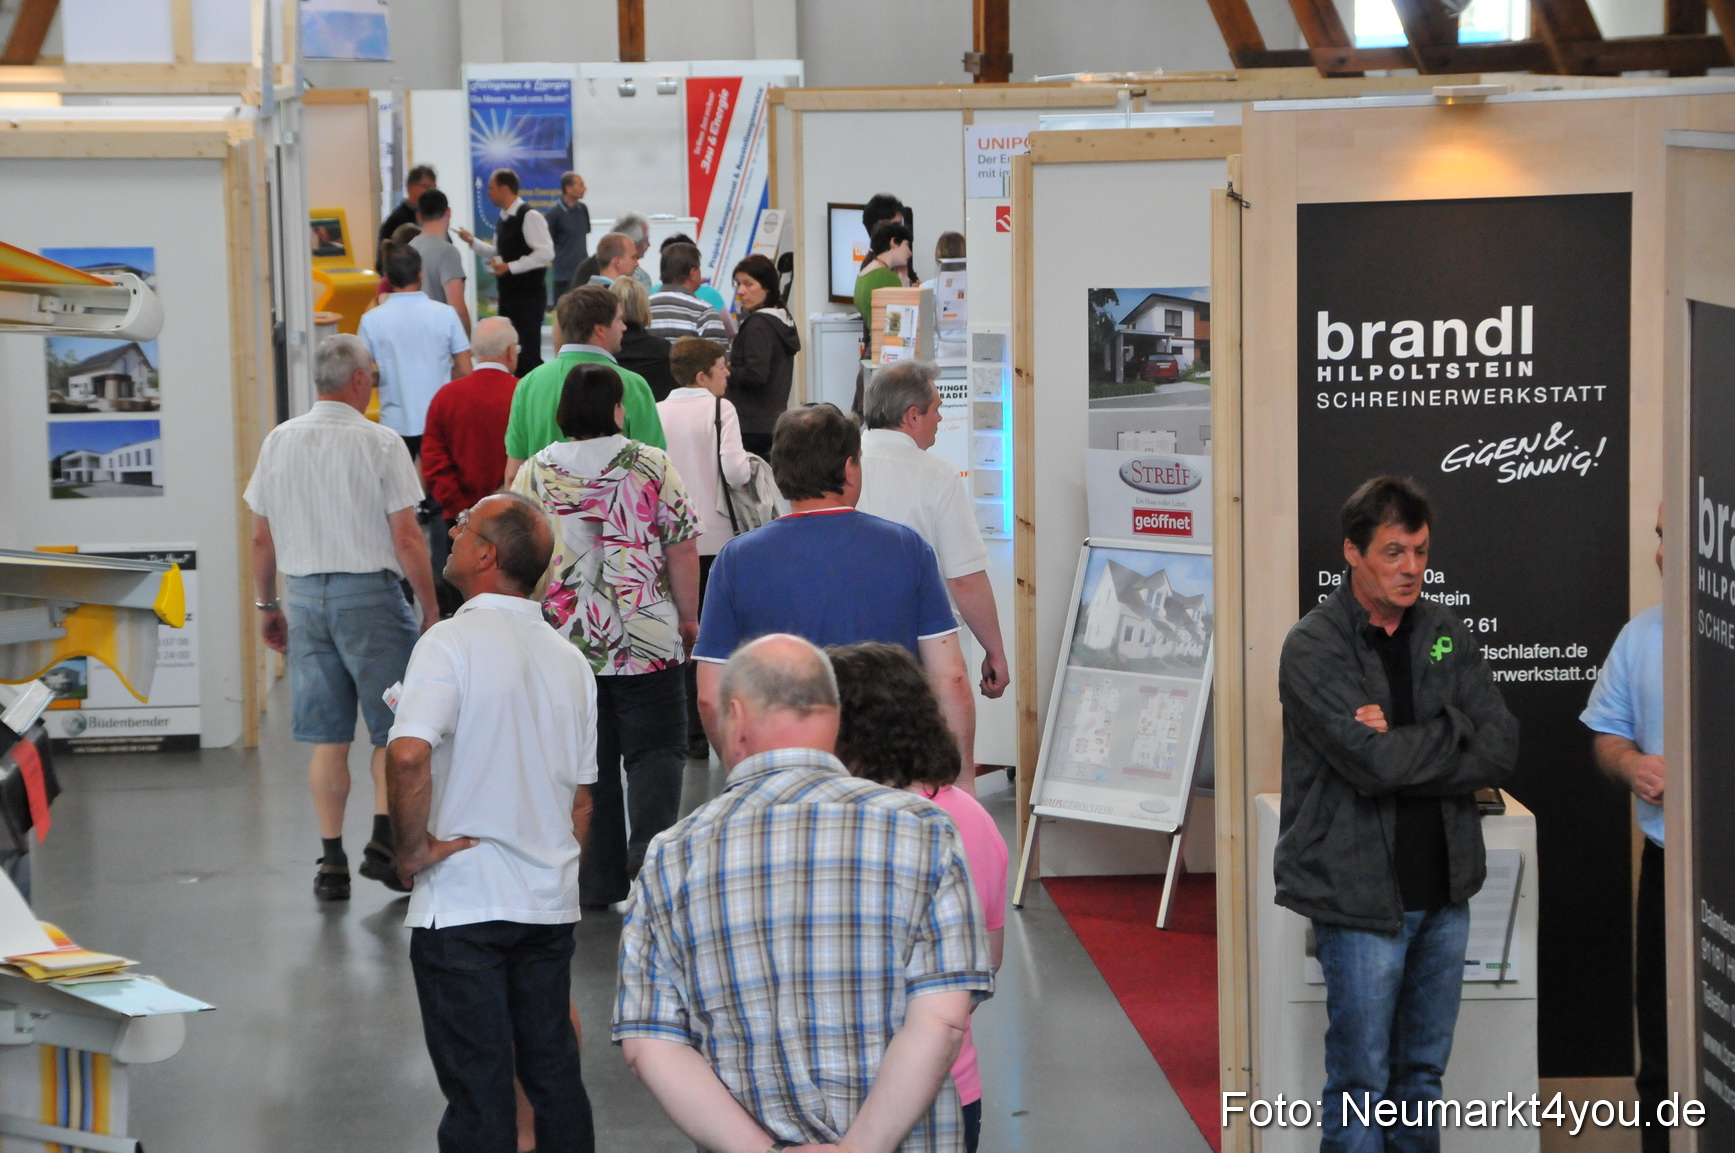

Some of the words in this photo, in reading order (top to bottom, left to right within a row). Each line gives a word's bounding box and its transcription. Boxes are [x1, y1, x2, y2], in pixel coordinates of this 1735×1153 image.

[709, 88, 730, 136] Energie
[707, 135, 717, 147] &
[978, 154, 997, 164] Der
[978, 169, 996, 178] mit
[1317, 305, 1533, 360] brandl
[1317, 361, 1533, 382] HILPOLTSTEIN
[1317, 385, 1607, 409] SCHREINERWERKSTATT
[1544, 421, 1574, 451] &
[1135, 513, 1191, 530] geöffnet
[1478, 617, 1498, 633] 61
